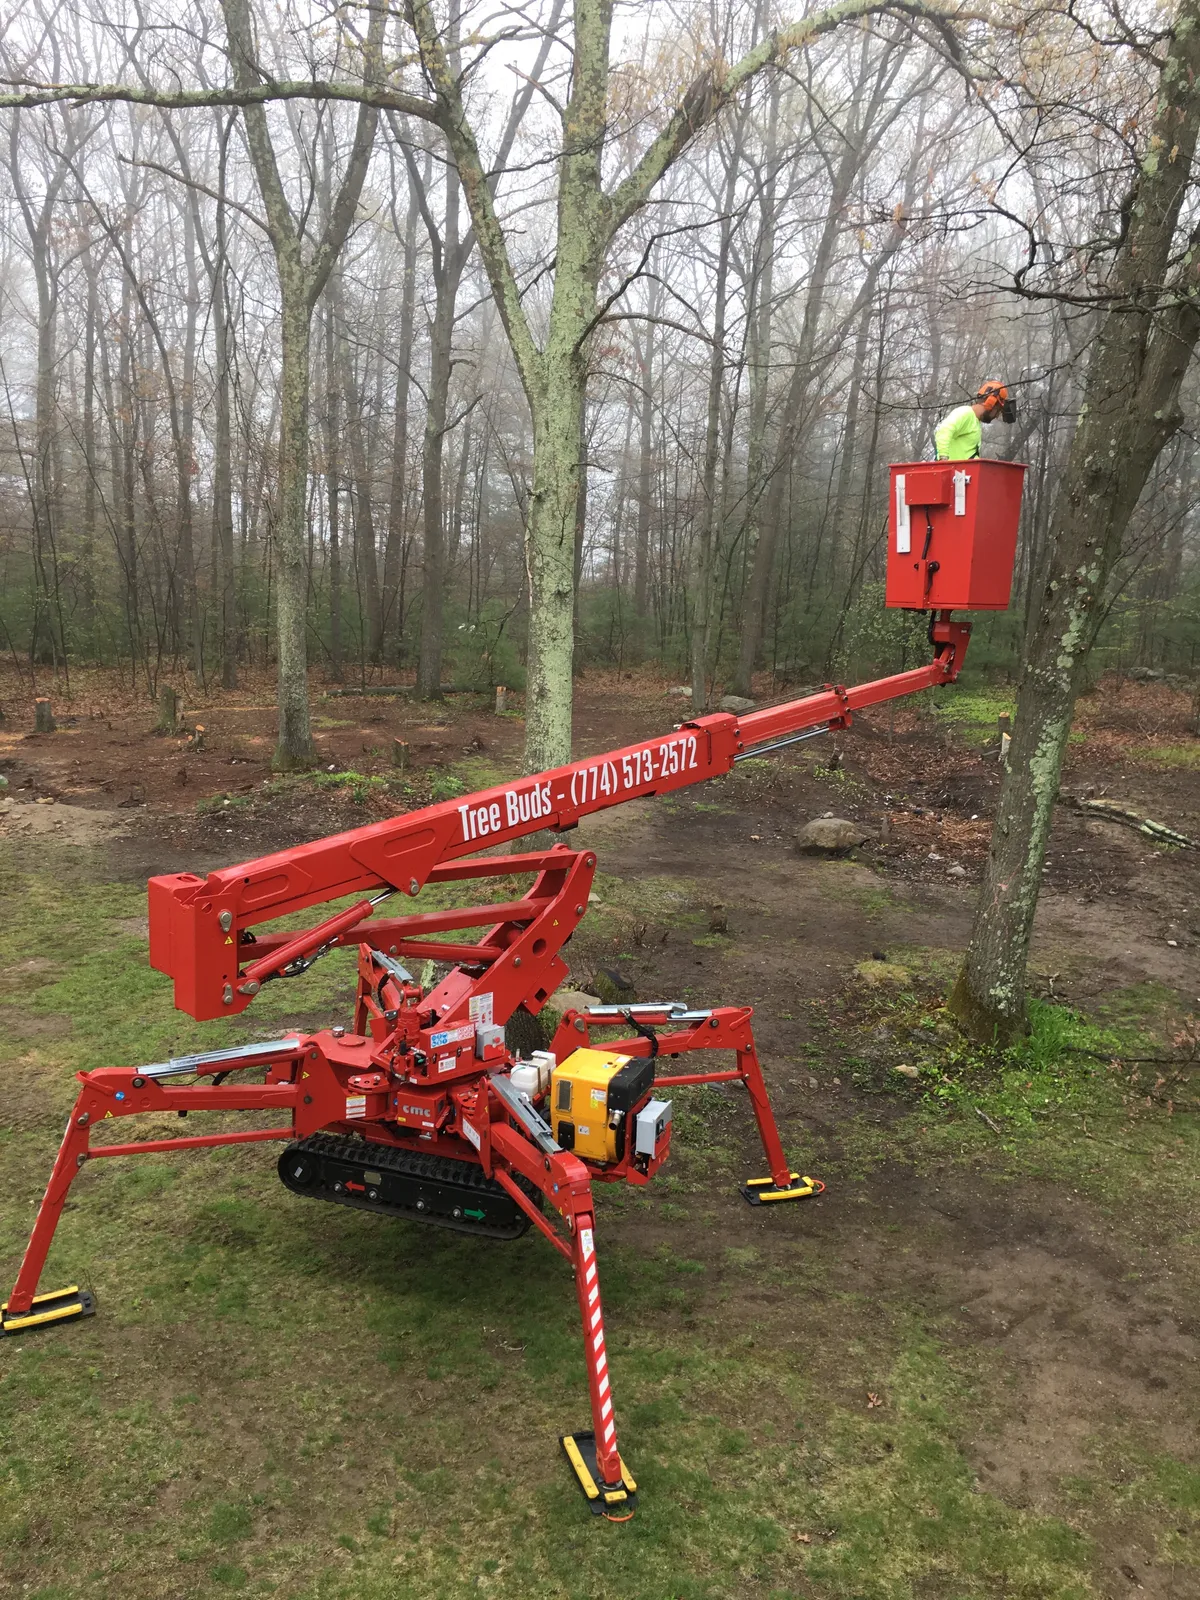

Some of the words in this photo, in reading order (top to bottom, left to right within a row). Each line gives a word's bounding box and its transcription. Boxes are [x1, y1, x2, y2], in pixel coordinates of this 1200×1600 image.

[458, 804, 501, 841] Tree
[570, 761, 618, 806] (774)
[622, 736, 698, 789] 573-2572
